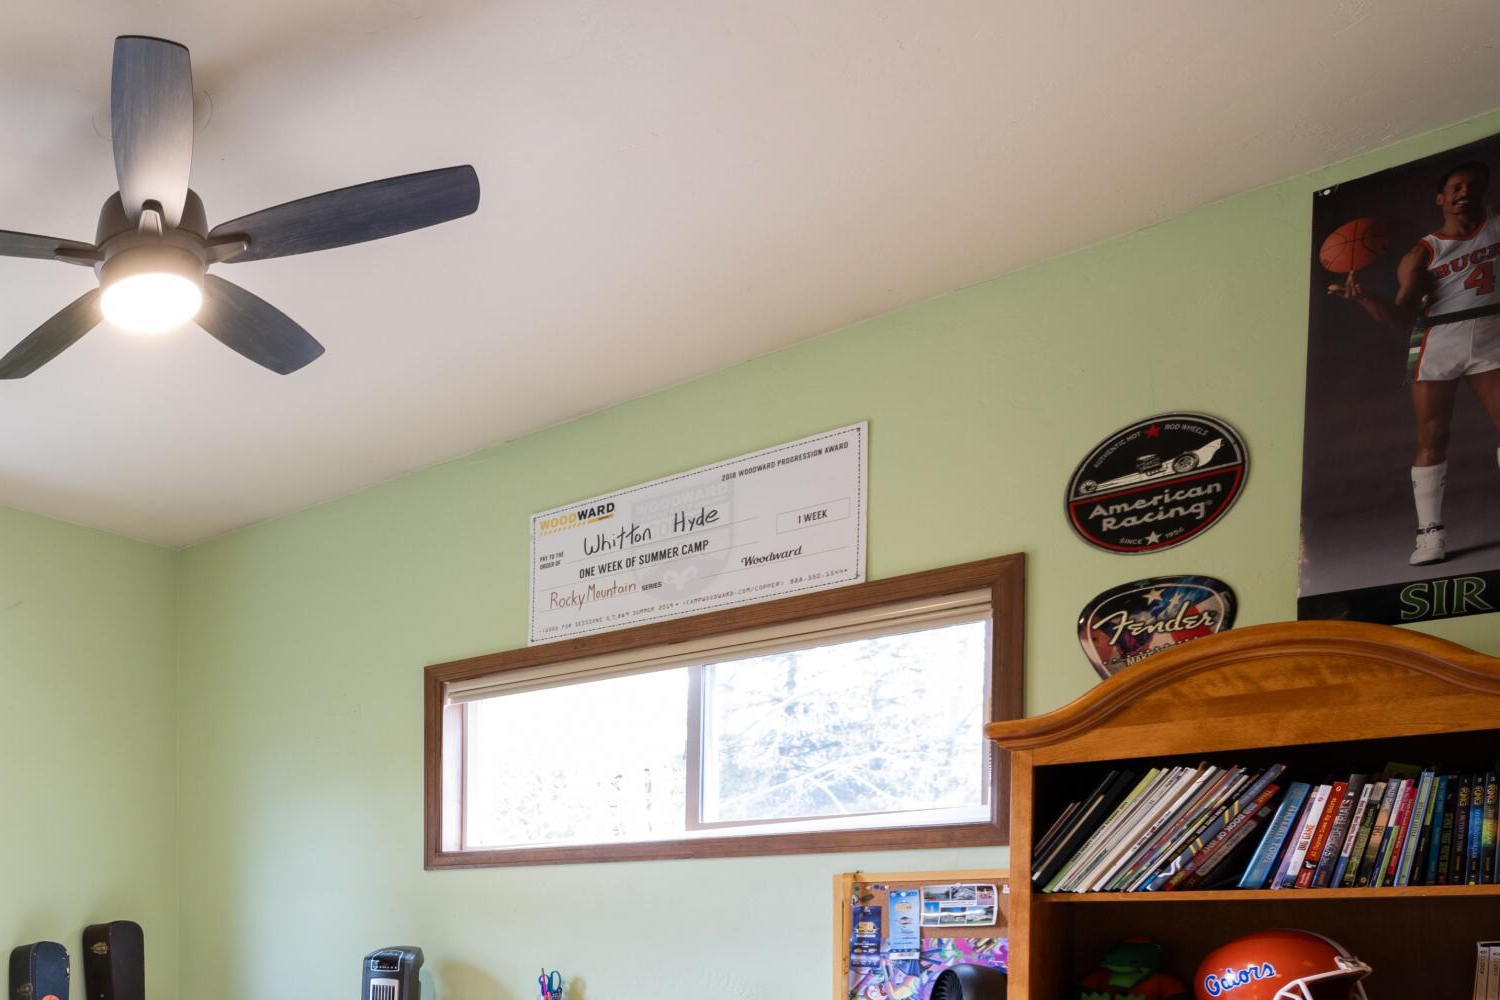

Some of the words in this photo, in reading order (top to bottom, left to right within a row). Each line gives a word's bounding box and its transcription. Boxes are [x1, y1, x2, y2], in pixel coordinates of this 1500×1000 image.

[738, 461, 776, 477] WOODWARD
[777, 448, 823, 467] PROGRESSION
[824, 441, 850, 457] AWARD
[539, 502, 616, 531] WOODWARD
[803, 508, 828, 523] WEEK
[1088, 480, 1222, 520] American
[1101, 501, 1206, 533] Racing
[583, 524, 652, 557] Whitton
[674, 506, 721, 534] Hyde
[579, 566, 596, 579] ONE
[598, 559, 624, 576] WEEK
[625, 556, 637, 570] OF
[638, 547, 679, 566] SUMMER
[681, 539, 709, 557] CAMP
[741, 545, 803, 567] Woodward
[550, 584, 585, 610] Rocky
[586, 579, 637, 603] Mountain
[641, 581, 663, 592] SERIES
[1399, 576, 1493, 621] SIR
[574, 617, 603, 629] SESSIONS
[1092, 600, 1216, 646] Fender
[1203, 961, 1277, 997] Gators
